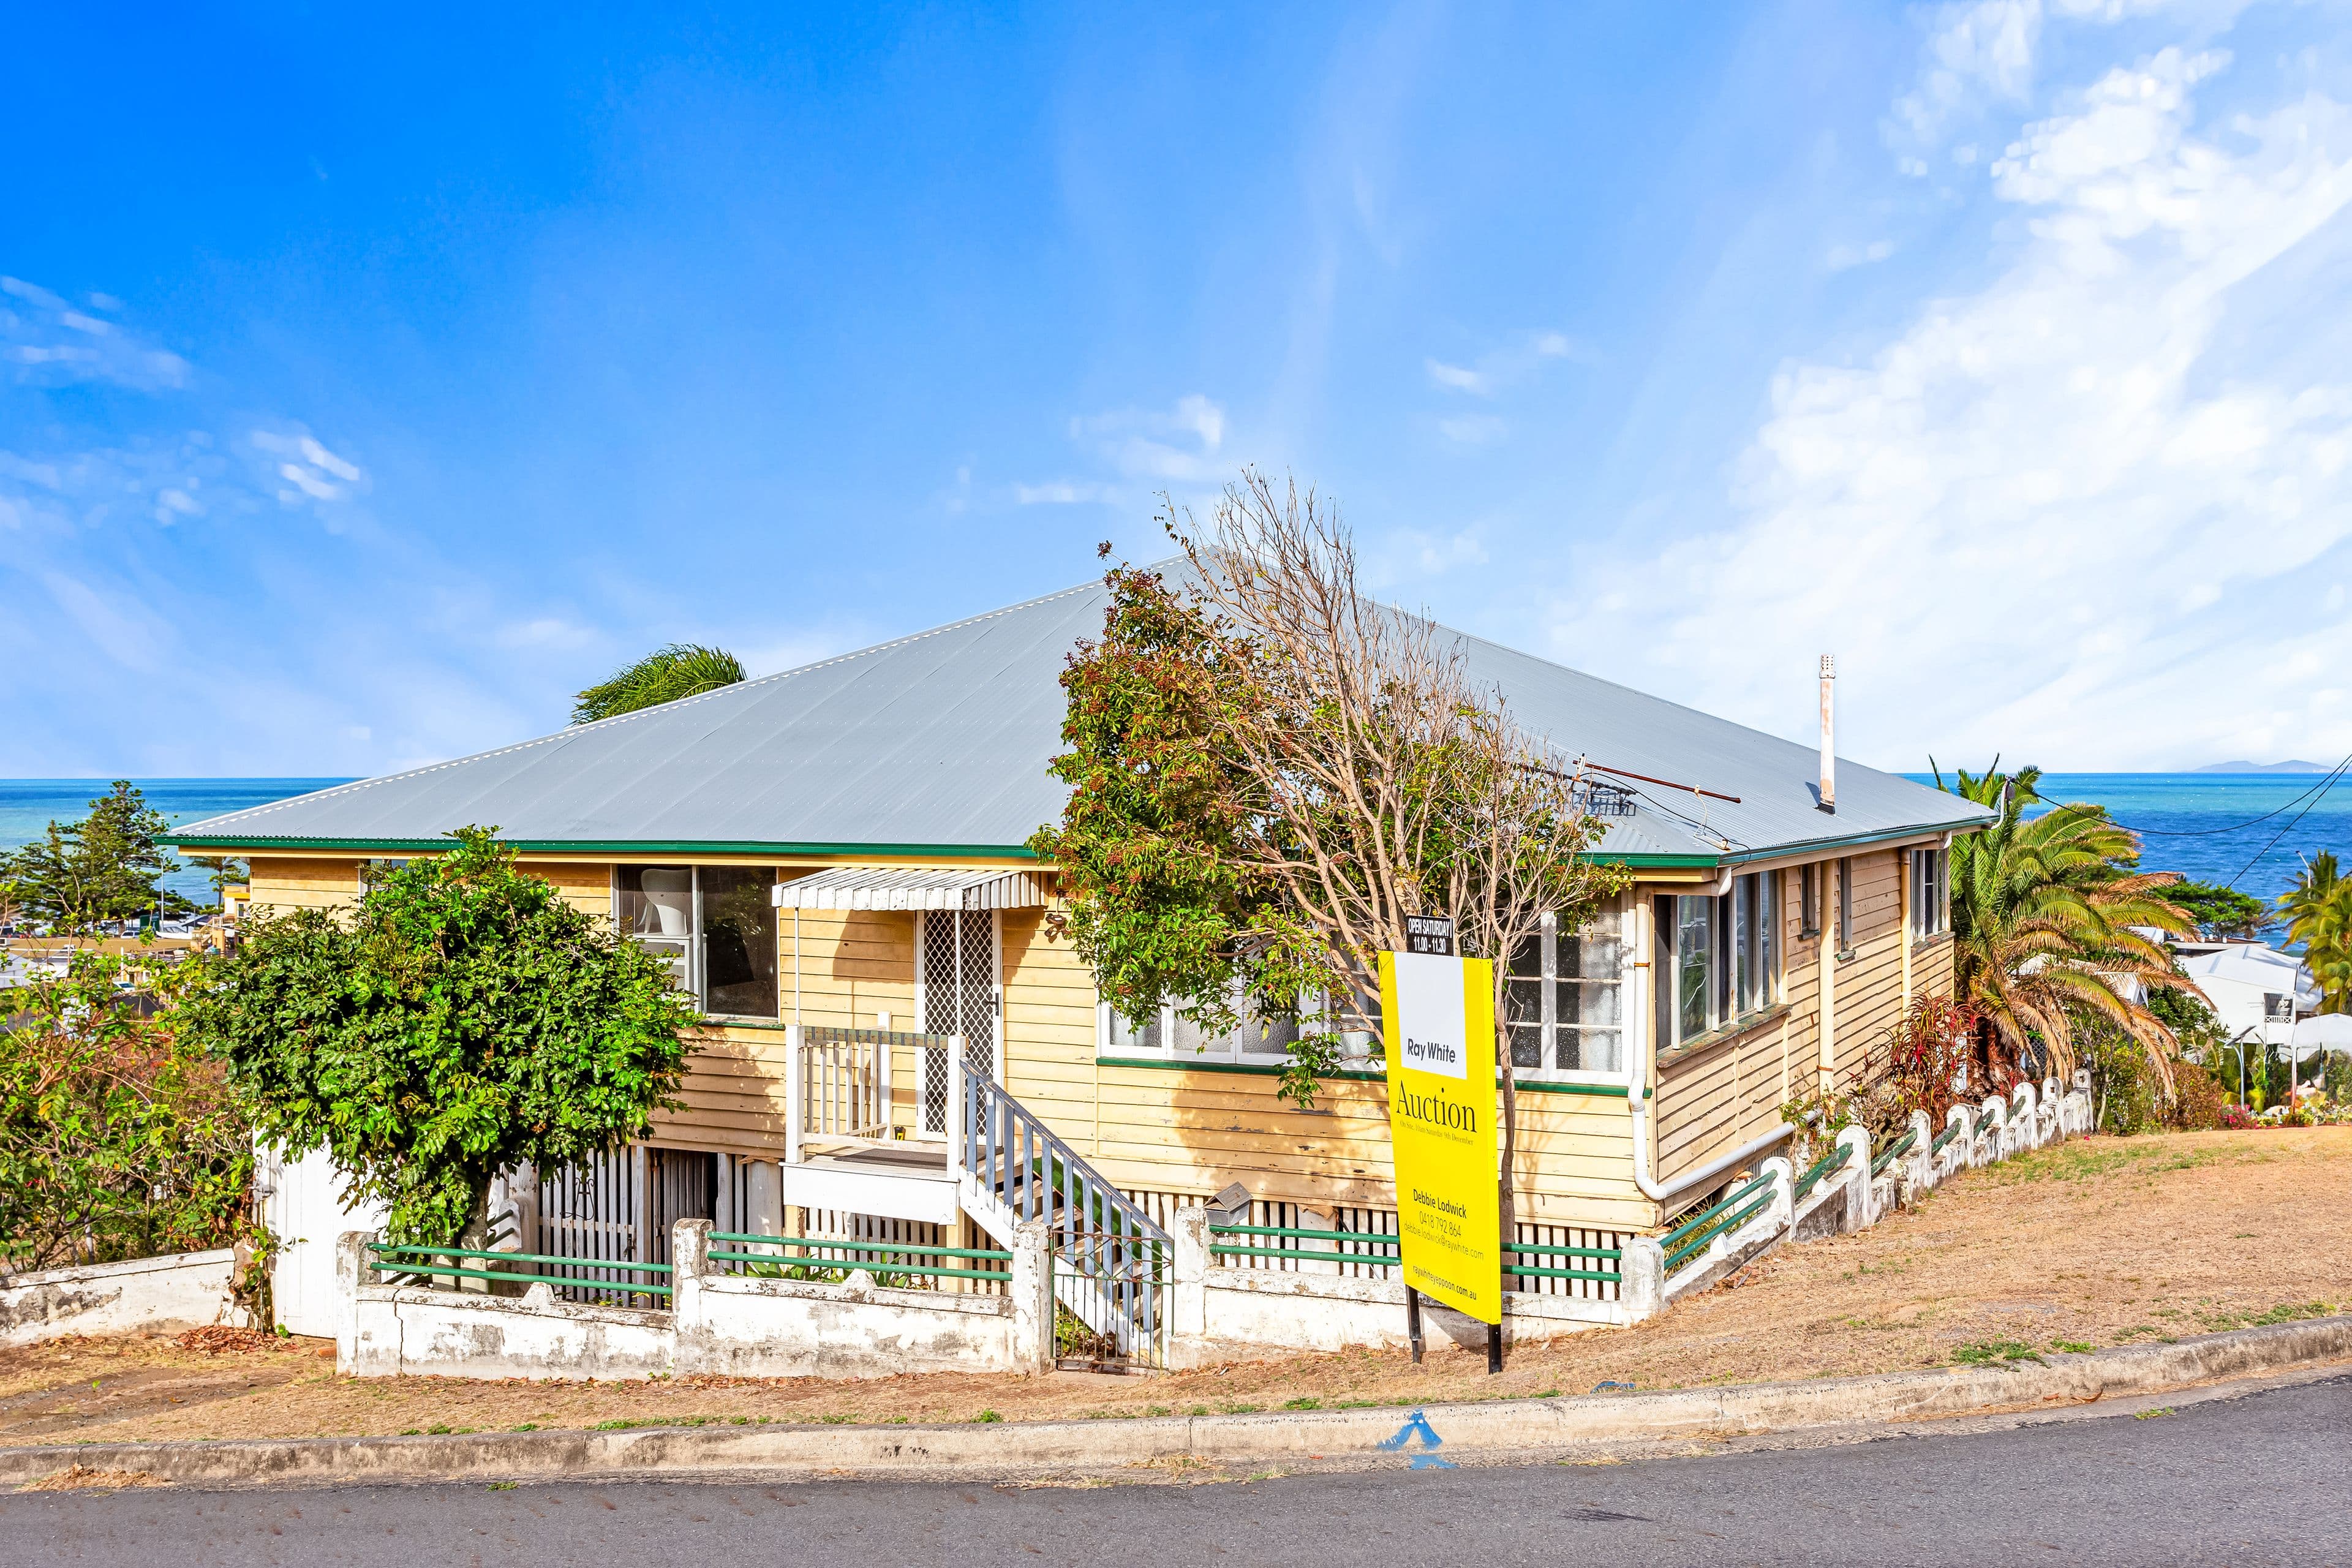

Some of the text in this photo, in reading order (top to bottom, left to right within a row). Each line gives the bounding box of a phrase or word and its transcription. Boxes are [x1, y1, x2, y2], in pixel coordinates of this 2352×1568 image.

[1408, 918, 1450, 937] OPEN SATURDAY
[1414, 937, 1428, 951] 11.00
[1432, 938, 1446, 954] 11.30
[1408, 1038, 1456, 1063] Ray White
[1396, 1080, 1477, 1133] Auction
[1426, 1128, 1443, 1138] Saturday
[1452, 1133, 1474, 1146] December
[1413, 1188, 1467, 1219] Debbie Lodwick
[1419, 1210, 1461, 1238] 0418 792 864
[1404, 1220, 1484, 1261] debbie.lodwick@raywhite.com
[1413, 1265, 1477, 1300] raywhiteyeppoon.com.au
